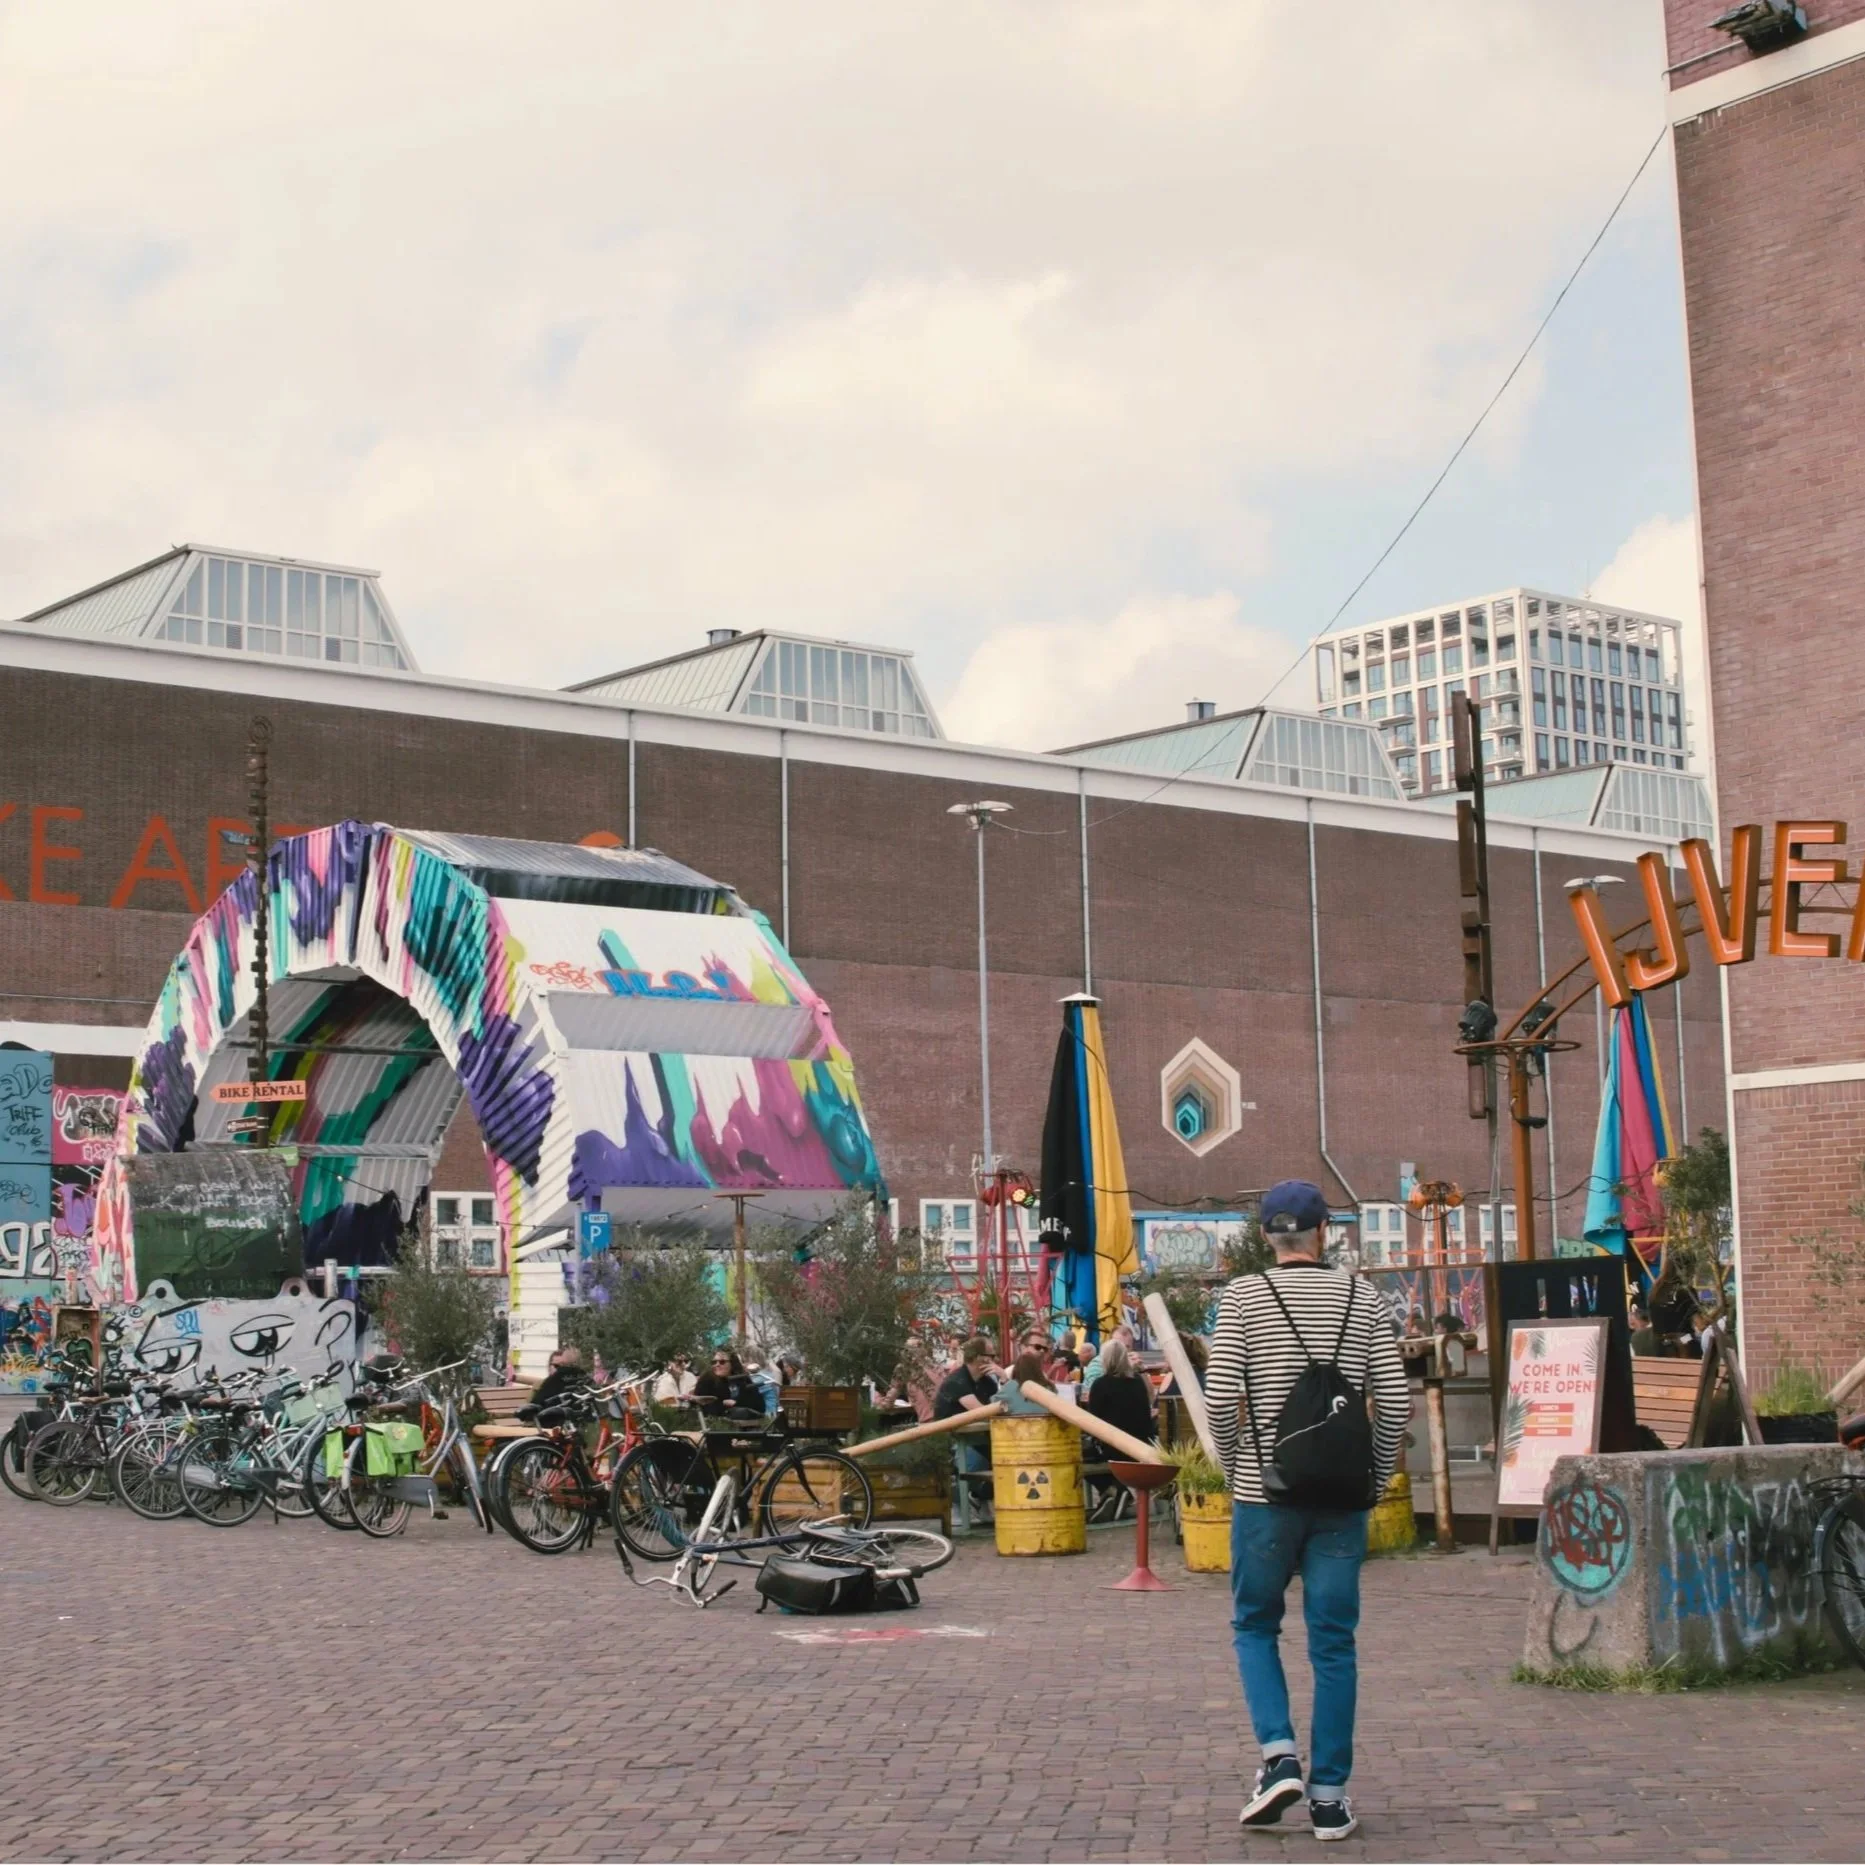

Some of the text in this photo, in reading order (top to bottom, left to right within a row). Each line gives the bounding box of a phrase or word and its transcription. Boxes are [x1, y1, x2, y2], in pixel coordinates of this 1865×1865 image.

[1568, 820, 1865, 1009] IJVE
[219, 1084, 304, 1098] BIKE RENTAL
[590, 1225, 602, 1243] P
[1522, 1364, 1560, 1377] COME
[1510, 1380, 1550, 1394] WE'RE
